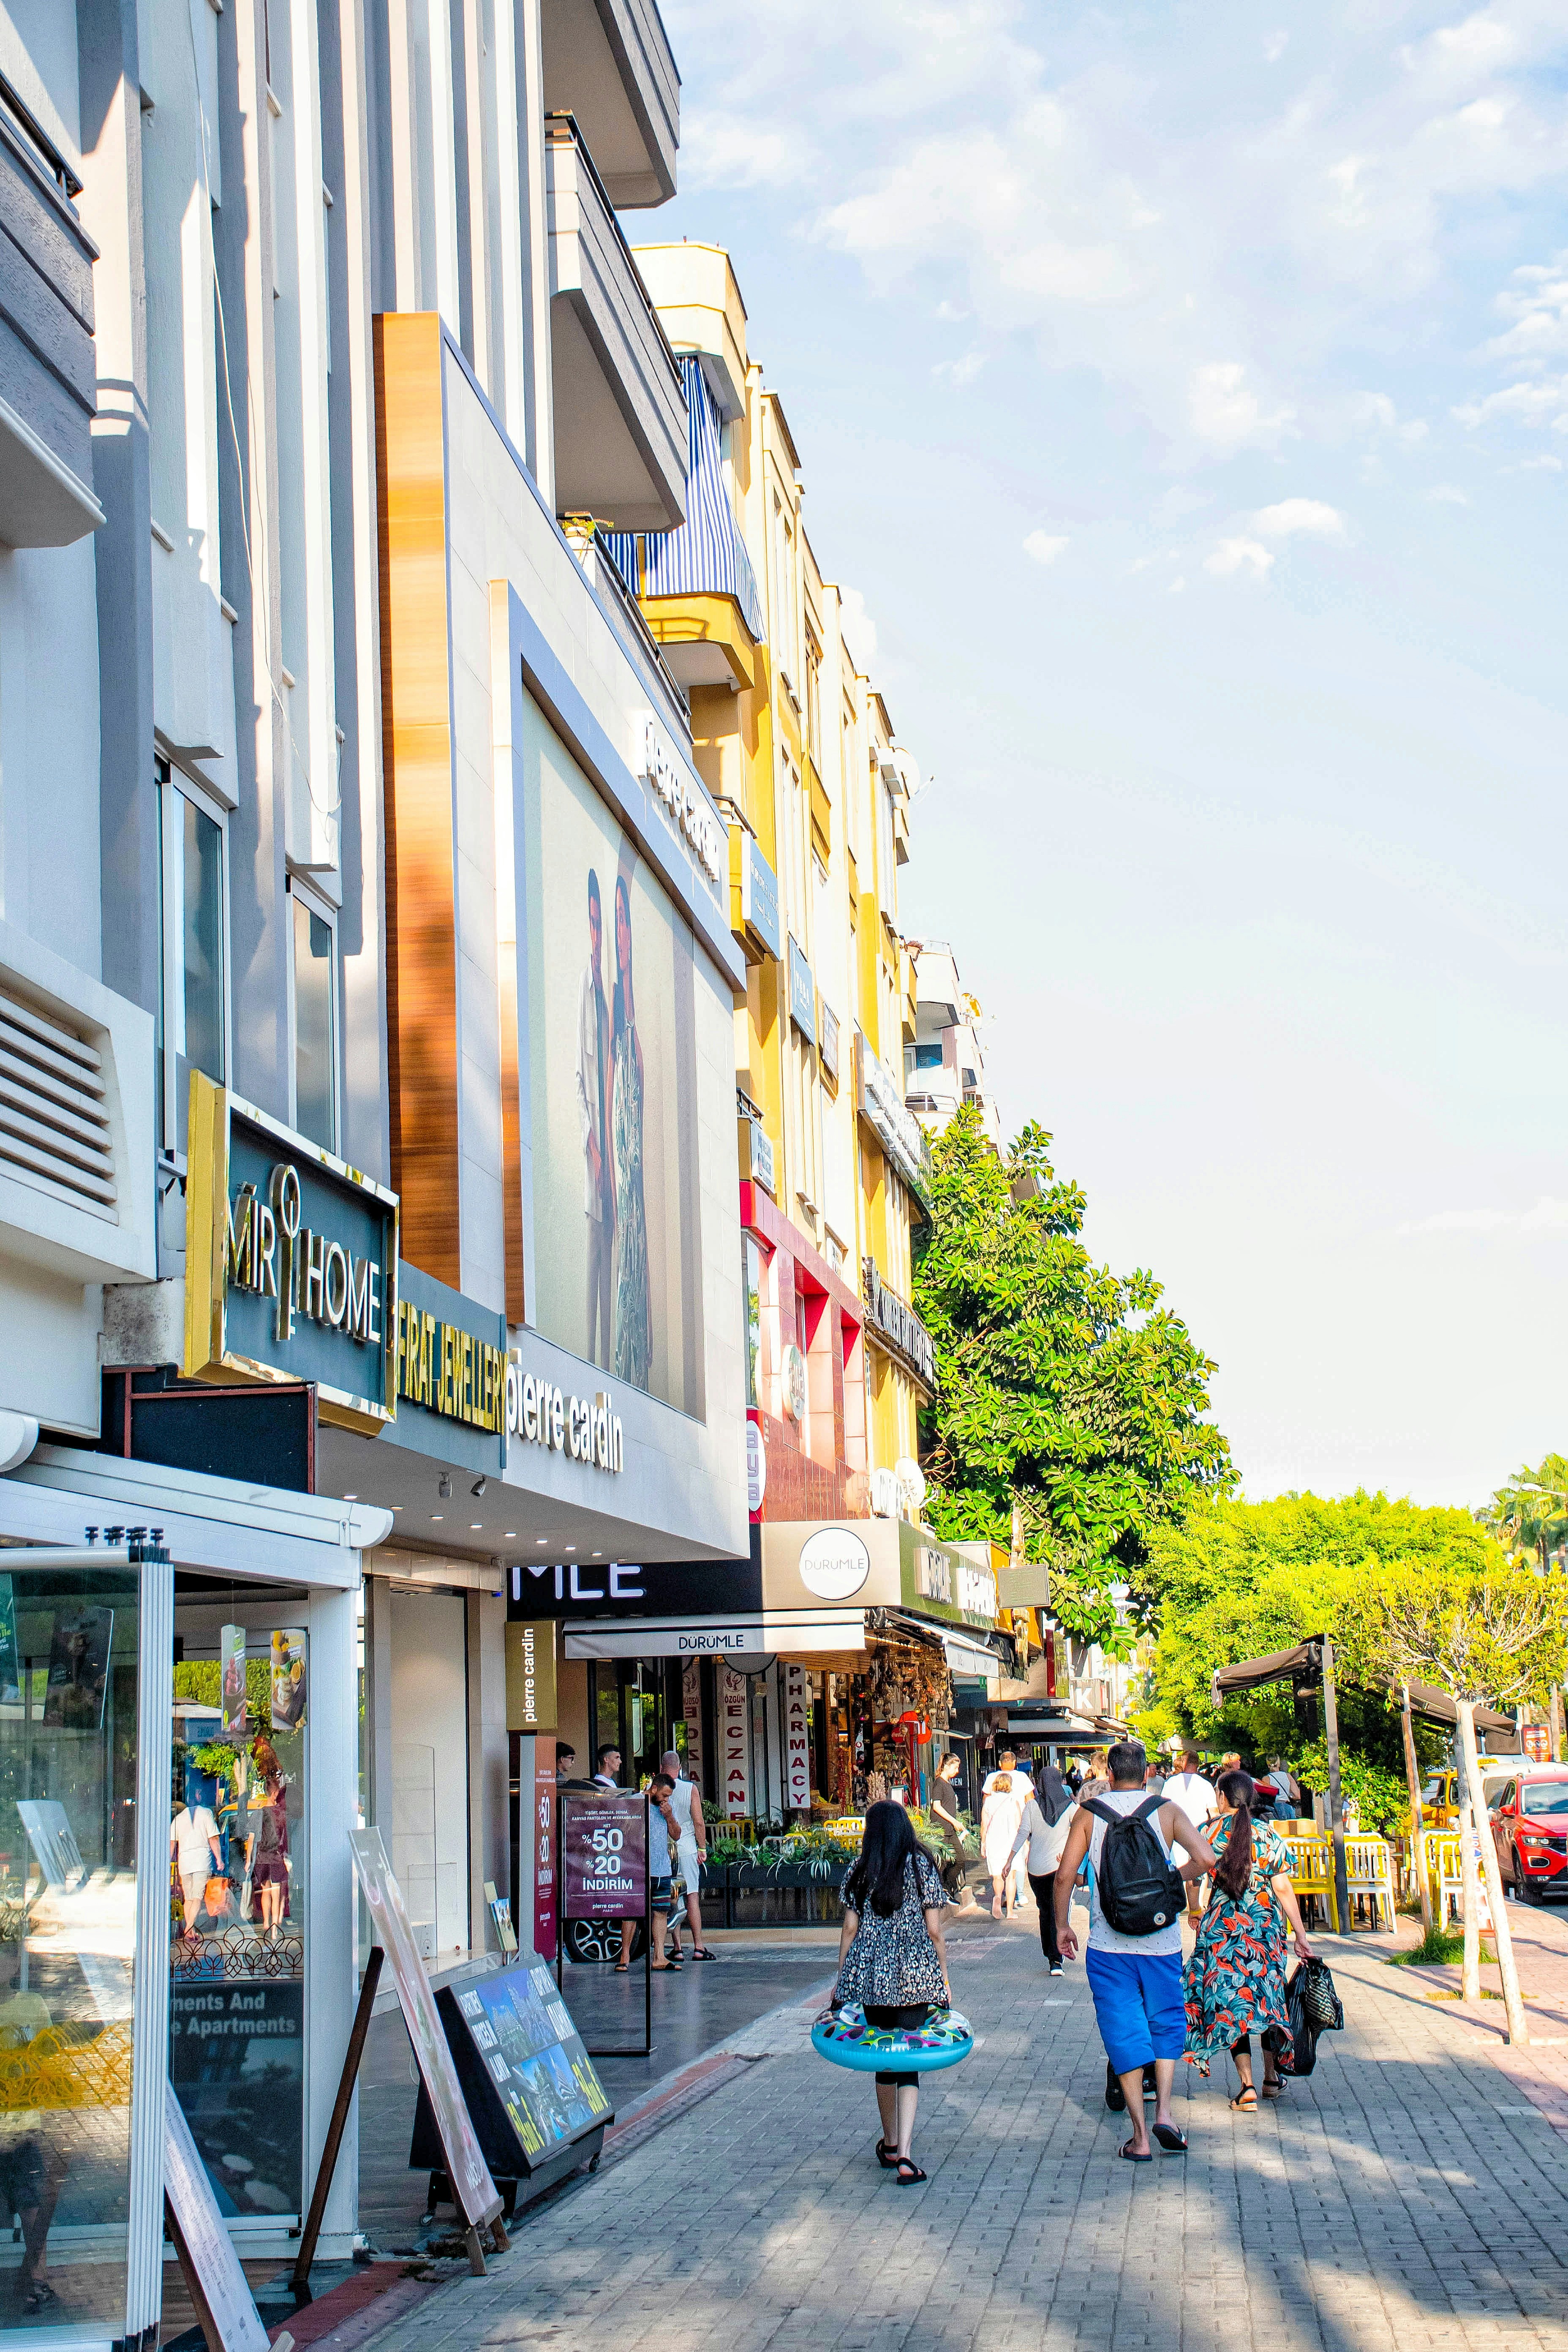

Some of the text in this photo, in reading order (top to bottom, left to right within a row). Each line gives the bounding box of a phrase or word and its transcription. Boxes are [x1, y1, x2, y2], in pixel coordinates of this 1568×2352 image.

[300, 1228, 381, 1343] HOME
[507, 1349, 624, 1473] pierre cardin
[678, 1634, 744, 1650] DÜRÜMLE
[522, 1628, 538, 1723] pierre cardin
[724, 1695, 745, 1704] ÖZGÜN
[789, 1666, 806, 1805] PHARMACY
[582, 1828, 623, 1851] %50
[586, 1855, 621, 1875] %20
[583, 1877, 632, 1890] İNDİRİM
[229, 1991, 265, 2010] And
[187, 2016, 297, 2039] Apartments
